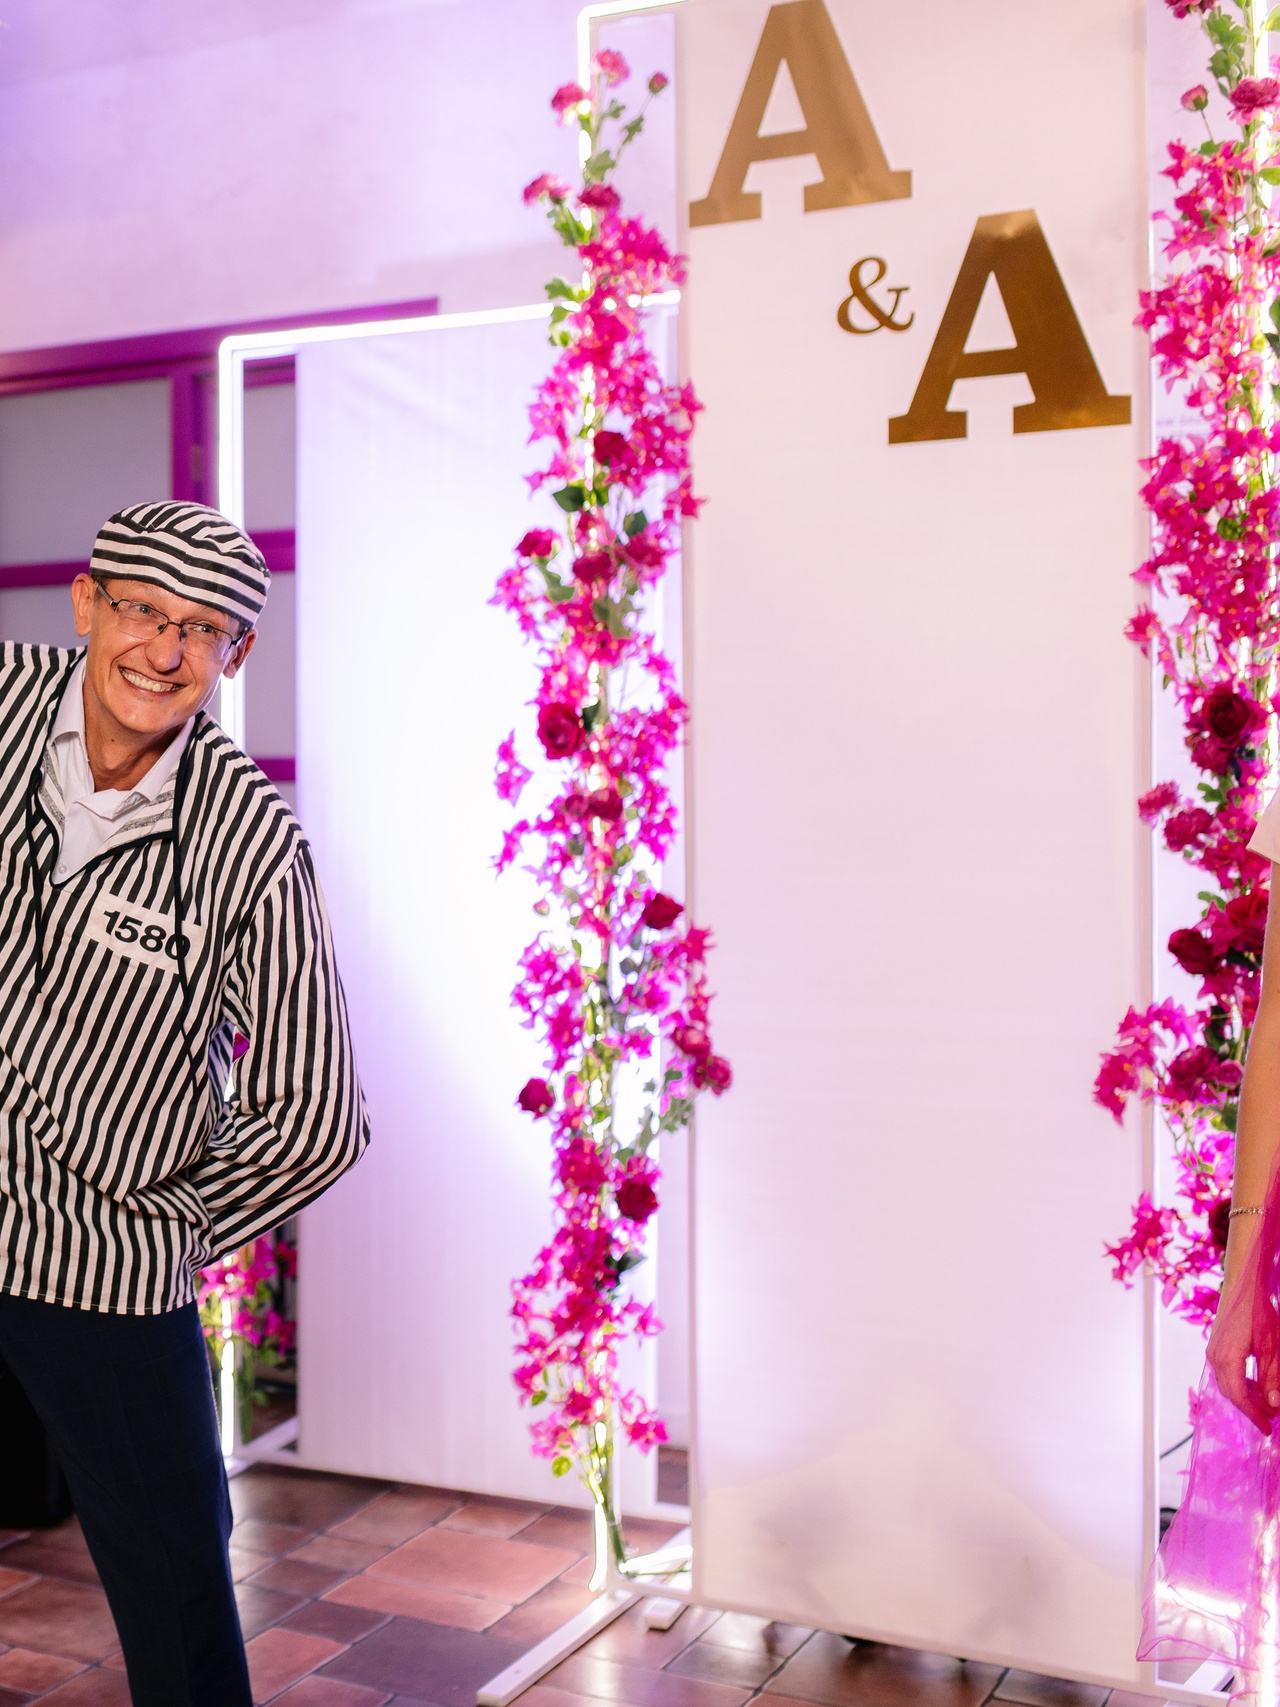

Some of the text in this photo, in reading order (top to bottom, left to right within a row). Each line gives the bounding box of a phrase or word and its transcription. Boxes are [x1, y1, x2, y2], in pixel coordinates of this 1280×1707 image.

[689, 0, 912, 228] A
[837, 208, 1132, 445] & A
[103, 910, 191, 960] 1580
